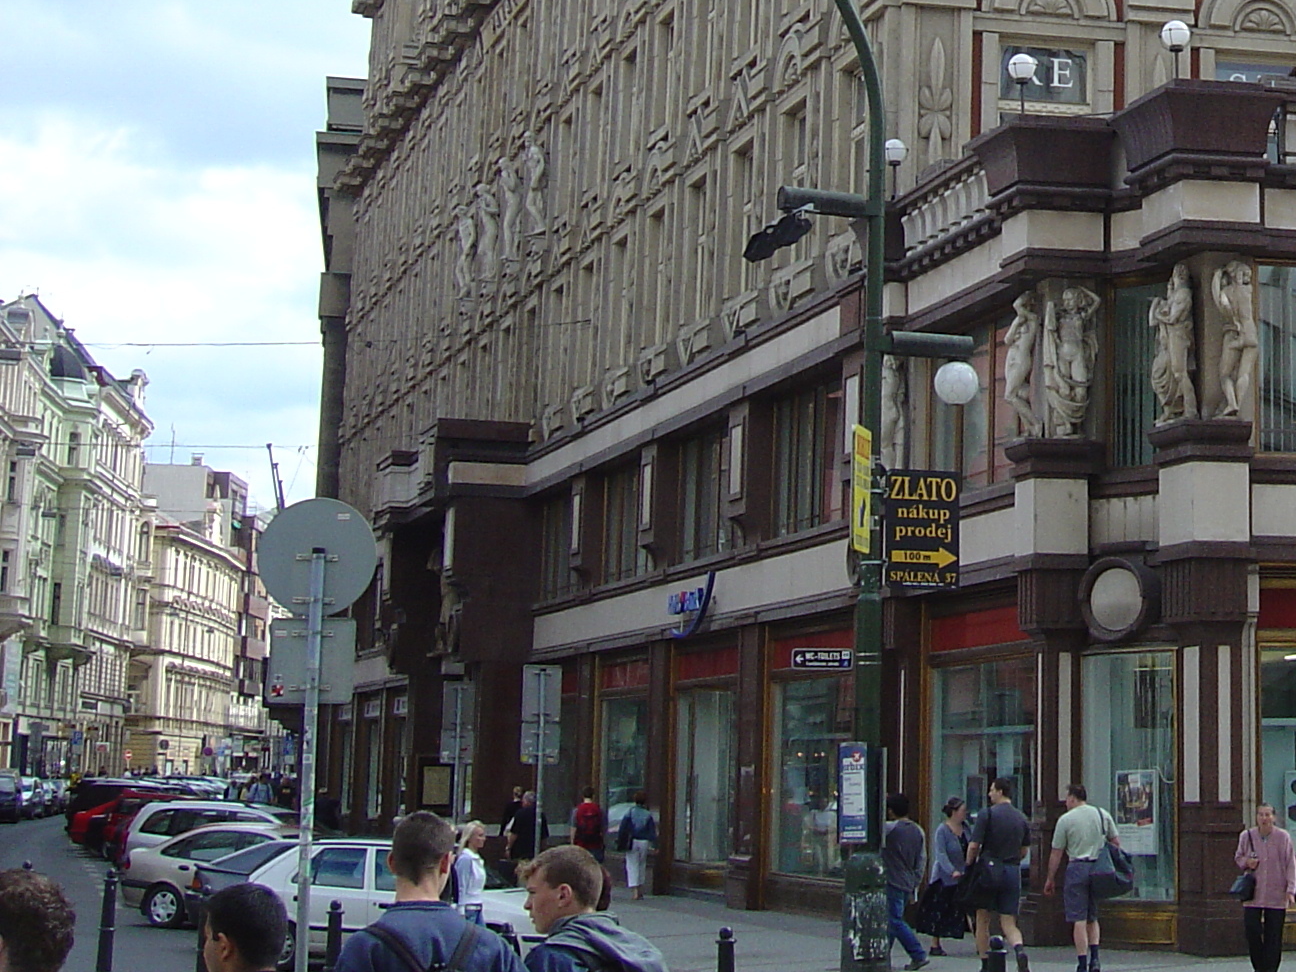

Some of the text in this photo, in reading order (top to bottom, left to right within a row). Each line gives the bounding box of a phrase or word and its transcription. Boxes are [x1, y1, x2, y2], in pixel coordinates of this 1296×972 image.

[890, 476, 957, 502] ZLATO
[897, 504, 950, 524] nákup
[895, 523, 952, 543] prodej
[903, 552, 921, 561] 100
[890, 569, 957, 583] SPÁLENÁ 37
